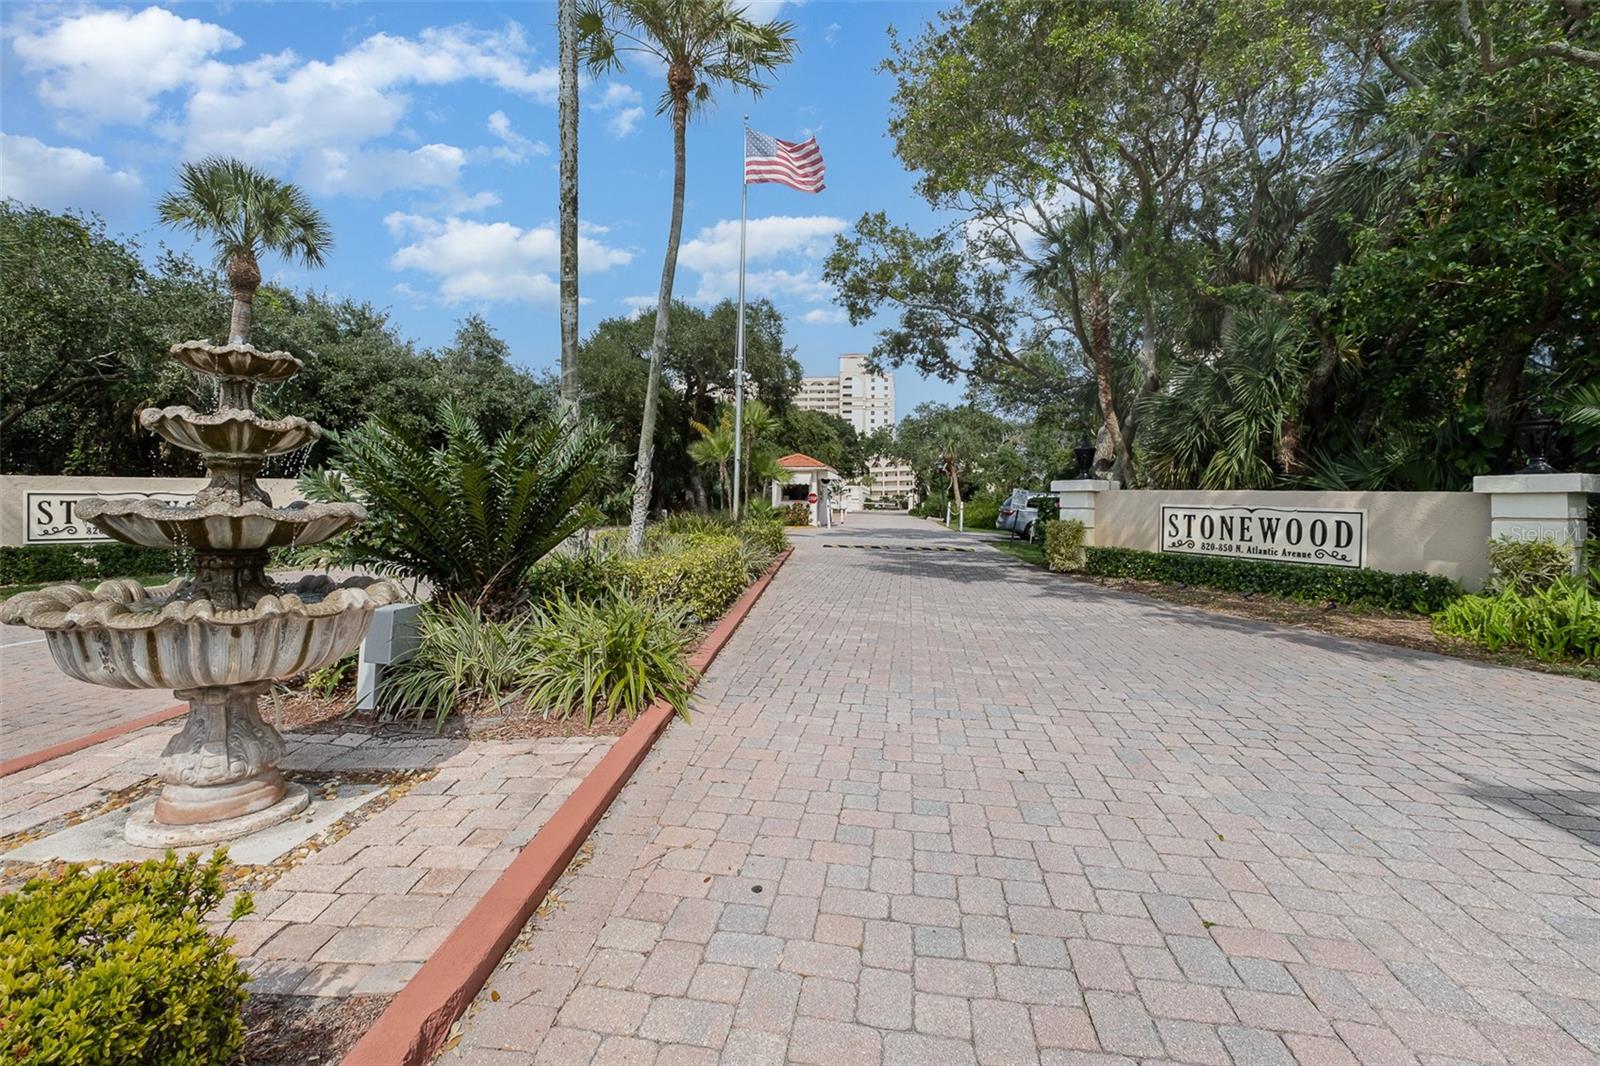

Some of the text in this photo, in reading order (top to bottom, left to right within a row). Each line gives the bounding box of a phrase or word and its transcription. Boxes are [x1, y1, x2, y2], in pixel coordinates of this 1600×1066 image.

[1168, 514, 1353, 548] STONEWOOD
[1201, 542, 1312, 559] 820-850 N. Atlantic Avenue
